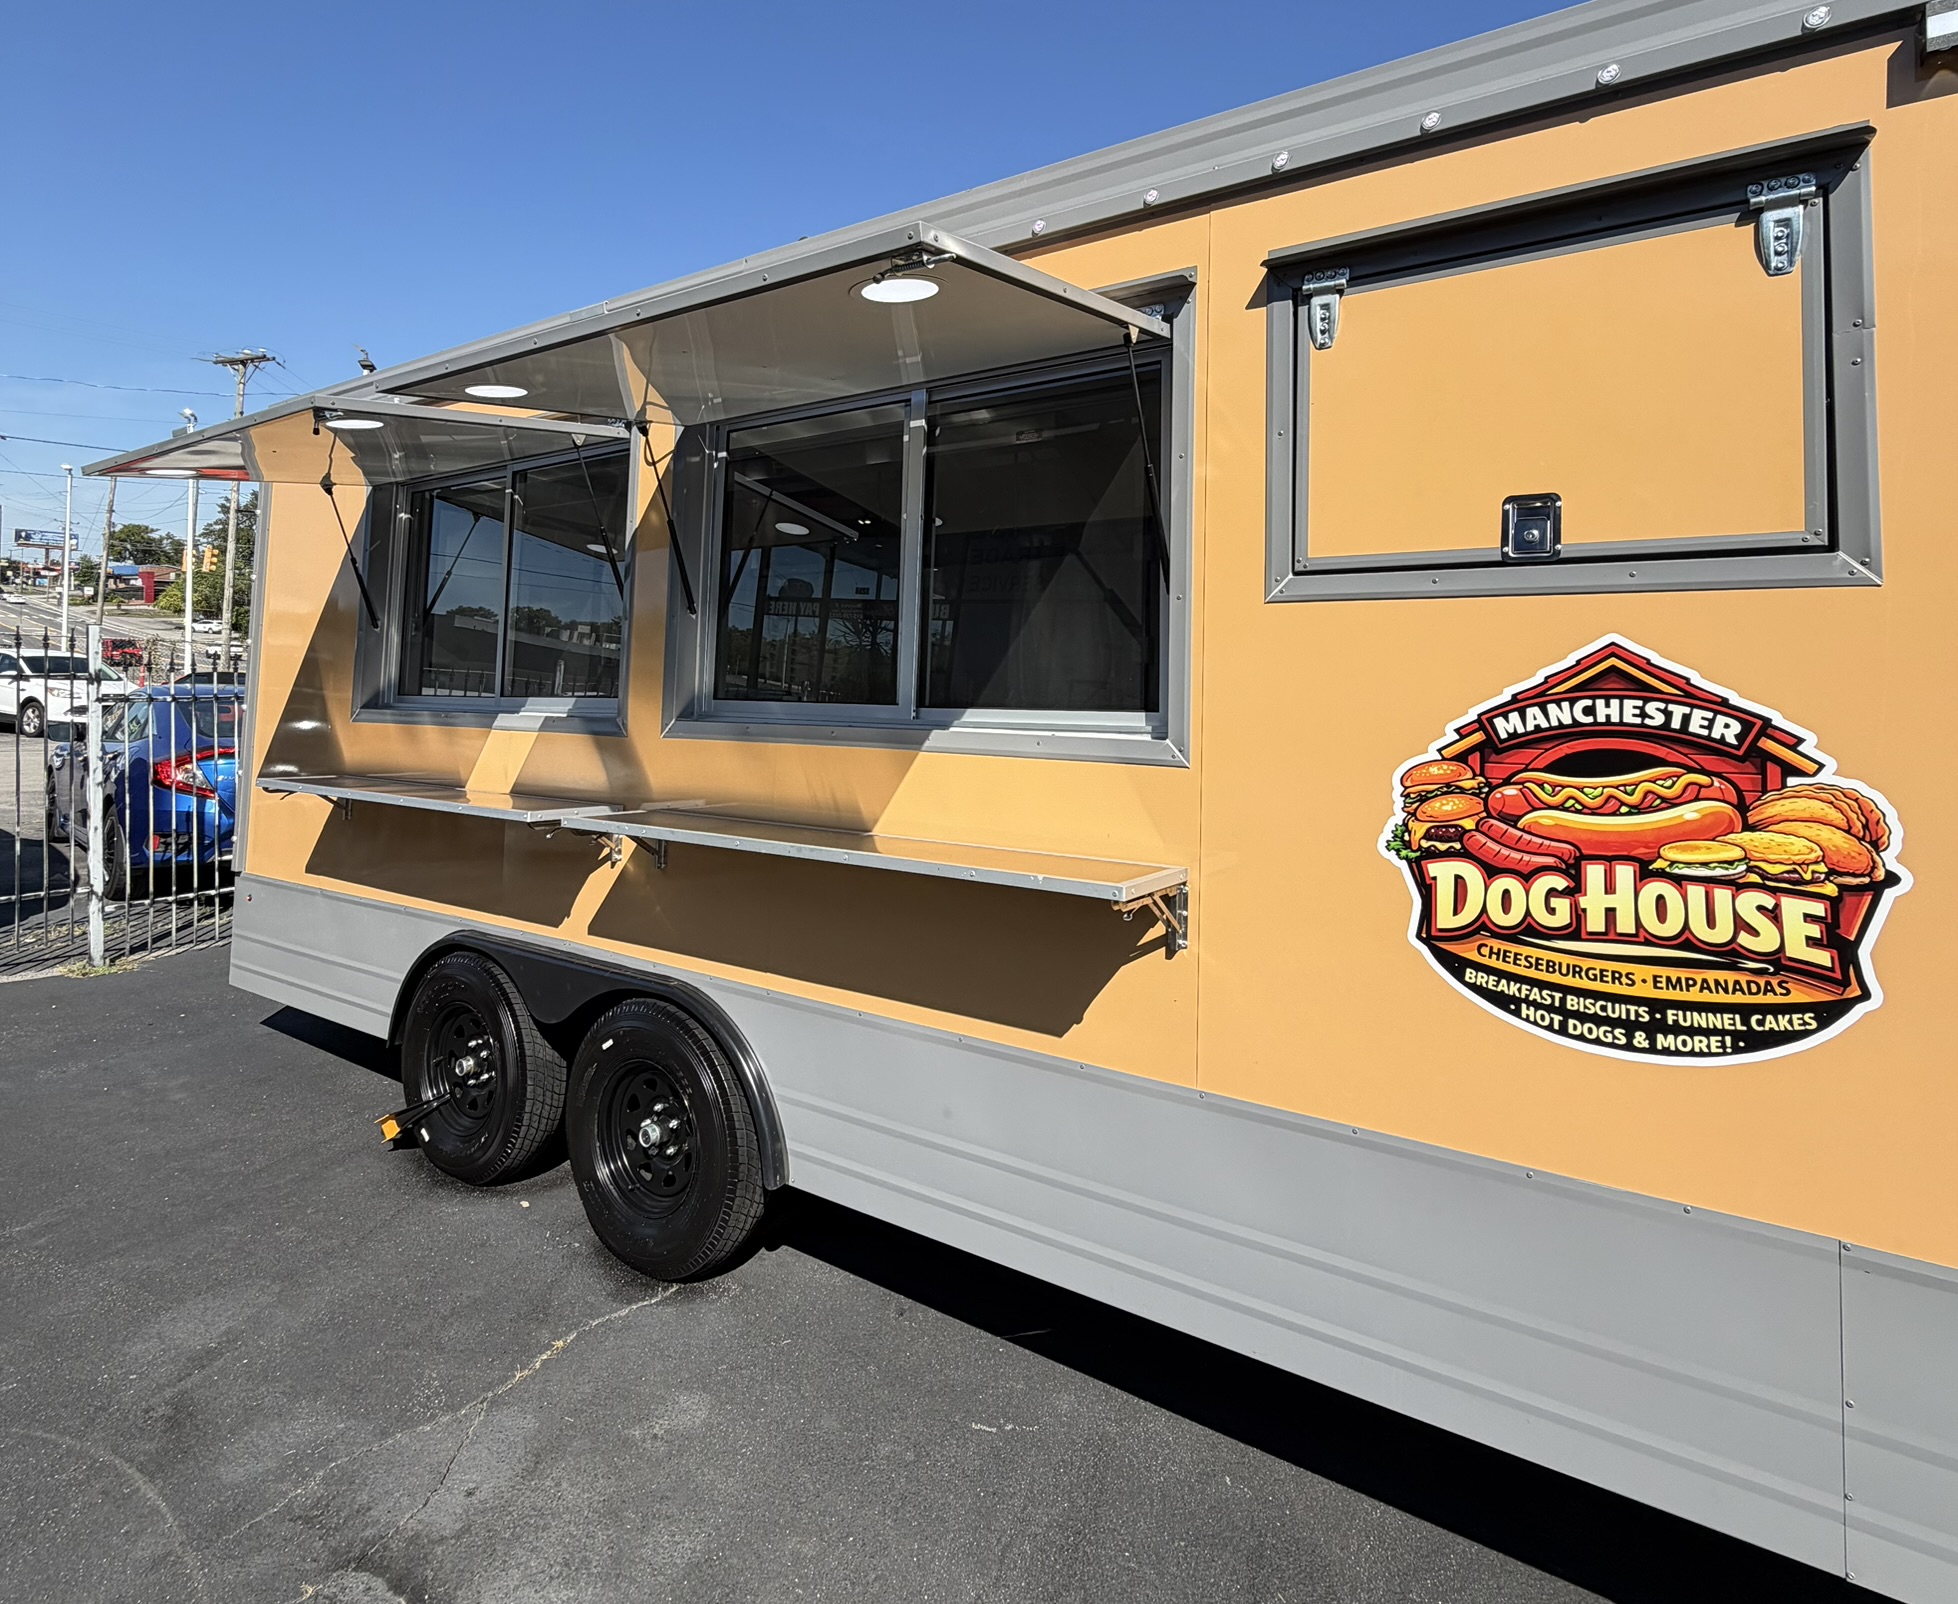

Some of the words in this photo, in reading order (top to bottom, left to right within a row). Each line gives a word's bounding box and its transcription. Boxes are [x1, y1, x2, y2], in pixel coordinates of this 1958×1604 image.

[1492, 698, 1742, 746] MANCHESTER
[1476, 942, 1637, 988] CHEESEBURGERS
[1651, 973, 1793, 998] EMPANADAS
[1464, 967, 1563, 1008] BREAKFAST
[1565, 994, 1650, 1023] BISCUITS
[1666, 1009, 1747, 1031] FUNNEL
[1750, 1012, 1818, 1031] CAKES
[1521, 1002, 1564, 1031] HOT
[1567, 1018, 1628, 1046] DOGS
[1632, 1031, 1650, 1048] &
[1656, 1033, 1733, 1053] MORE!
